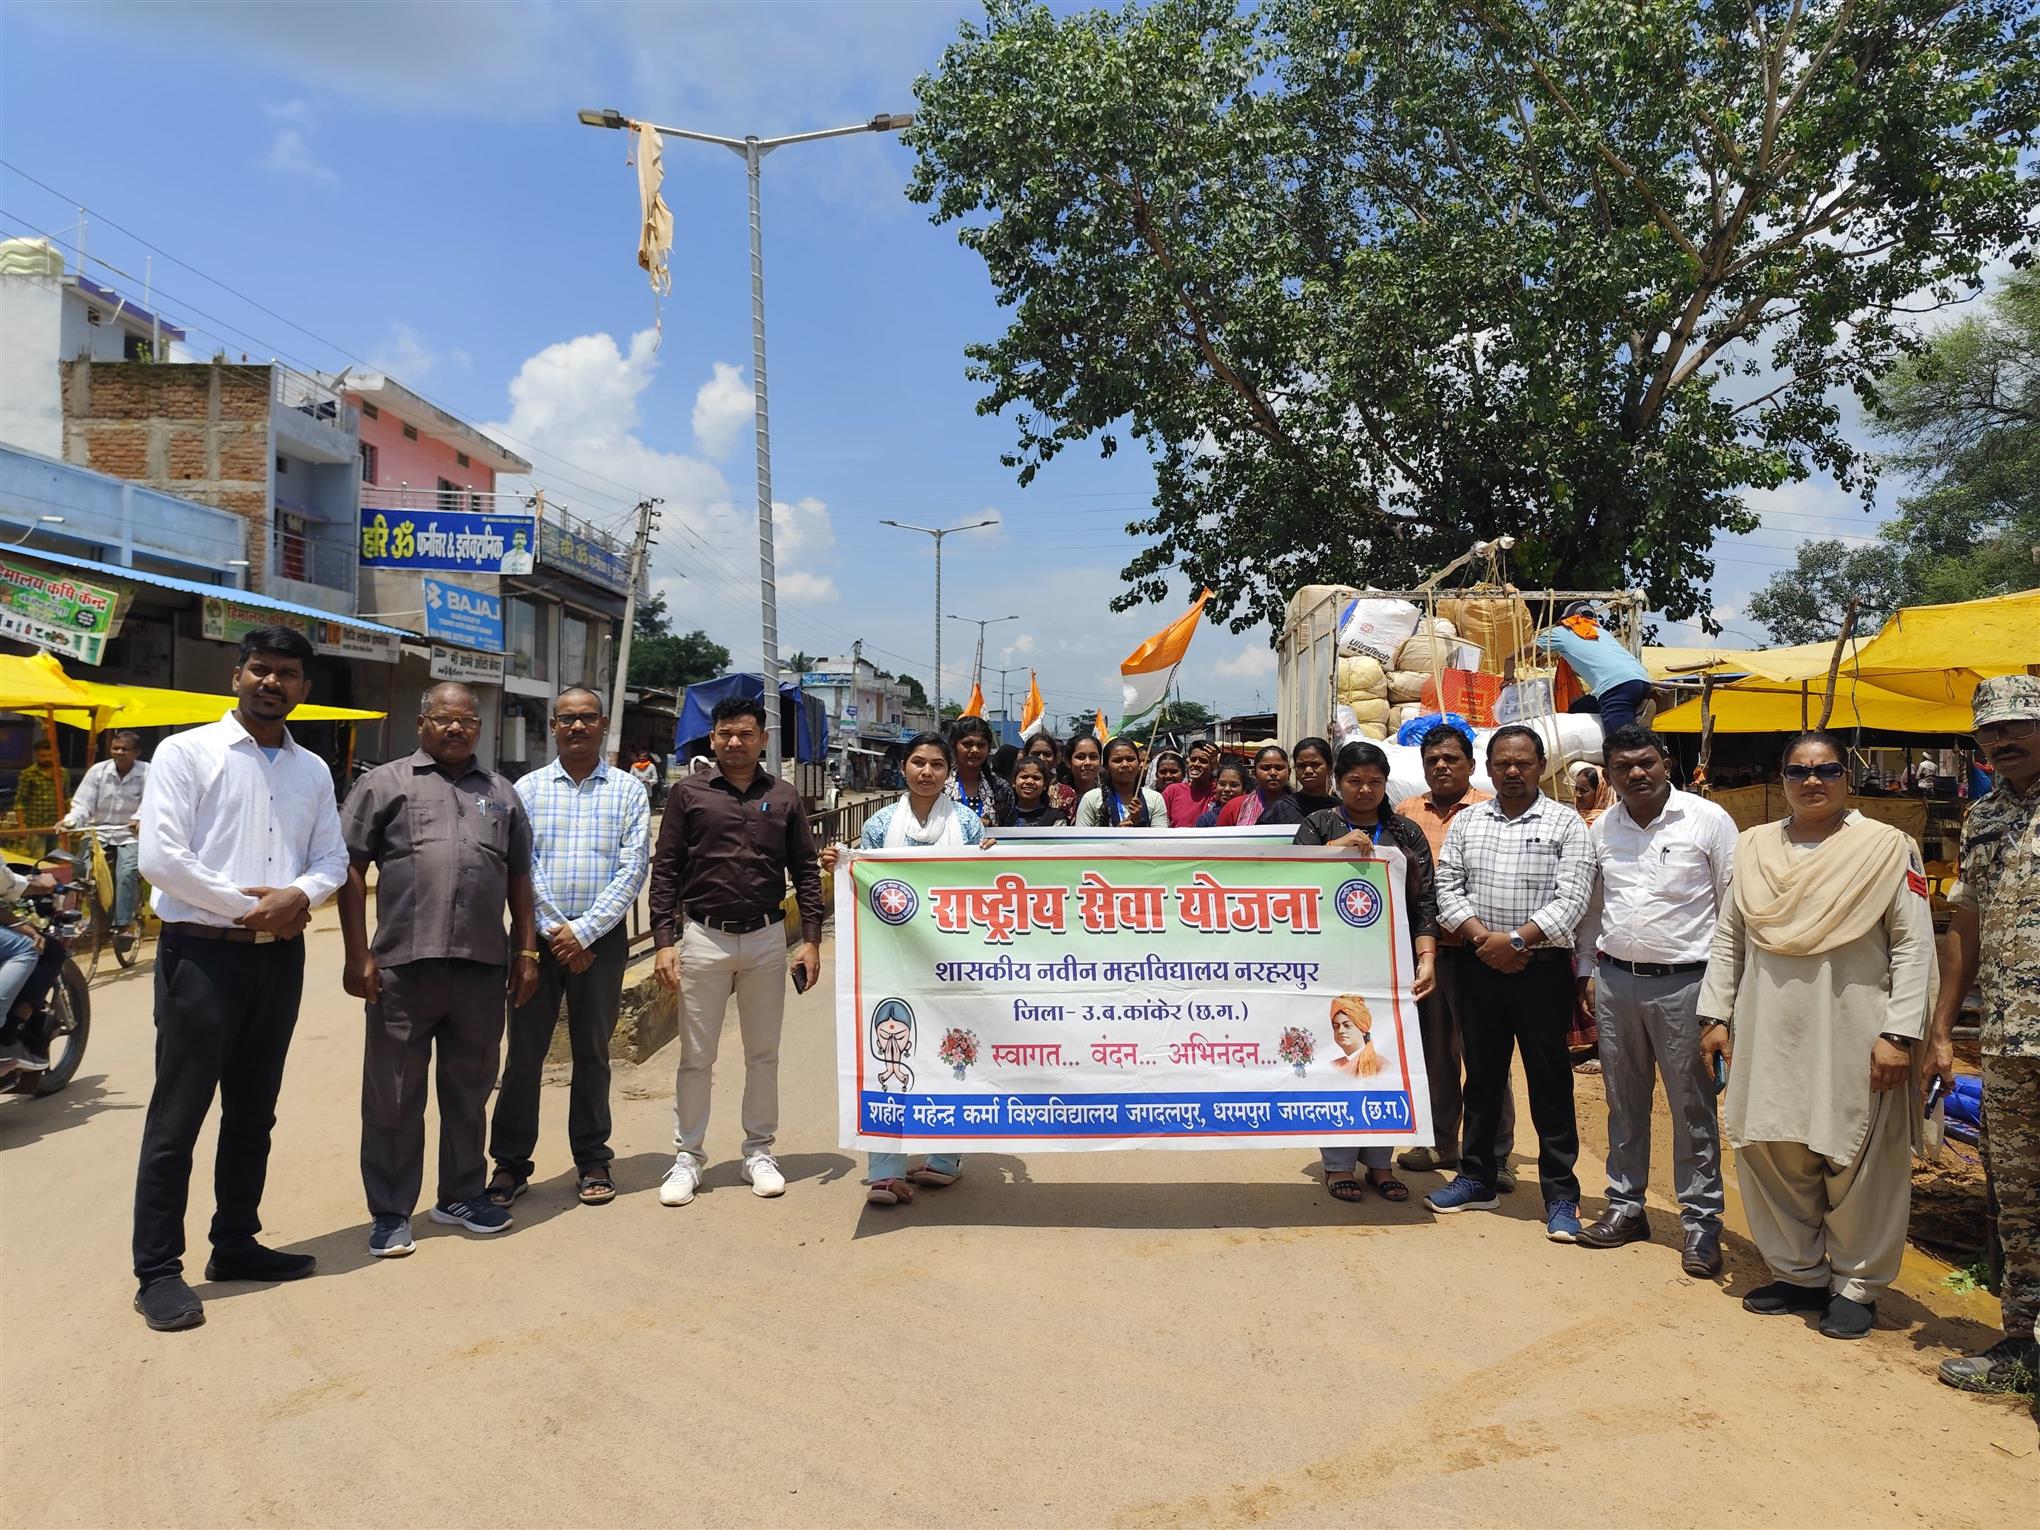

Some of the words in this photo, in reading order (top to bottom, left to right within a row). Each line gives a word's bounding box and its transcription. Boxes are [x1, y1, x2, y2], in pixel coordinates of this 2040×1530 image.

[362, 513, 389, 559] हरि
[391, 520, 415, 559] ॐ
[447, 531, 455, 559] &
[447, 590, 500, 621] BAJAJ
[1349, 639, 1390, 661] UltraTech
[928, 873, 1069, 944] राष्ट्रीय
[1077, 871, 1168, 934] सेवा
[1175, 871, 1323, 935] योजना
[935, 954, 1030, 982] शासकीय
[1036, 954, 1098, 982] नवीन
[1102, 954, 1229, 982] महाविद्यालय
[1234, 961, 1320, 989] नरहरपुर
[1082, 999, 1182, 1021] उ.ब.कांकेर
[1188, 1002, 1249, 1022] (छ.ग.)
[991, 1043, 1080, 1068] स्वागत...
[1091, 1034, 1157, 1068] वंदन...
[1168, 1032, 1277, 1068] अभिनंदन...
[868, 1097, 906, 1126] शहीद
[913, 1097, 955, 1127] महेन्द्र
[963, 1096, 1000, 1125] कर्मा
[1007, 1096, 1118, 1126] विश्वविद्यालय
[1125, 1101, 1206, 1130] जगदलपुर,
[1213, 1101, 1270, 1129] धरमपुरा
[1277, 1101, 1354, 1128] जगदलपुर,
[1361, 1095, 1409, 1126] (छ.ग.)
